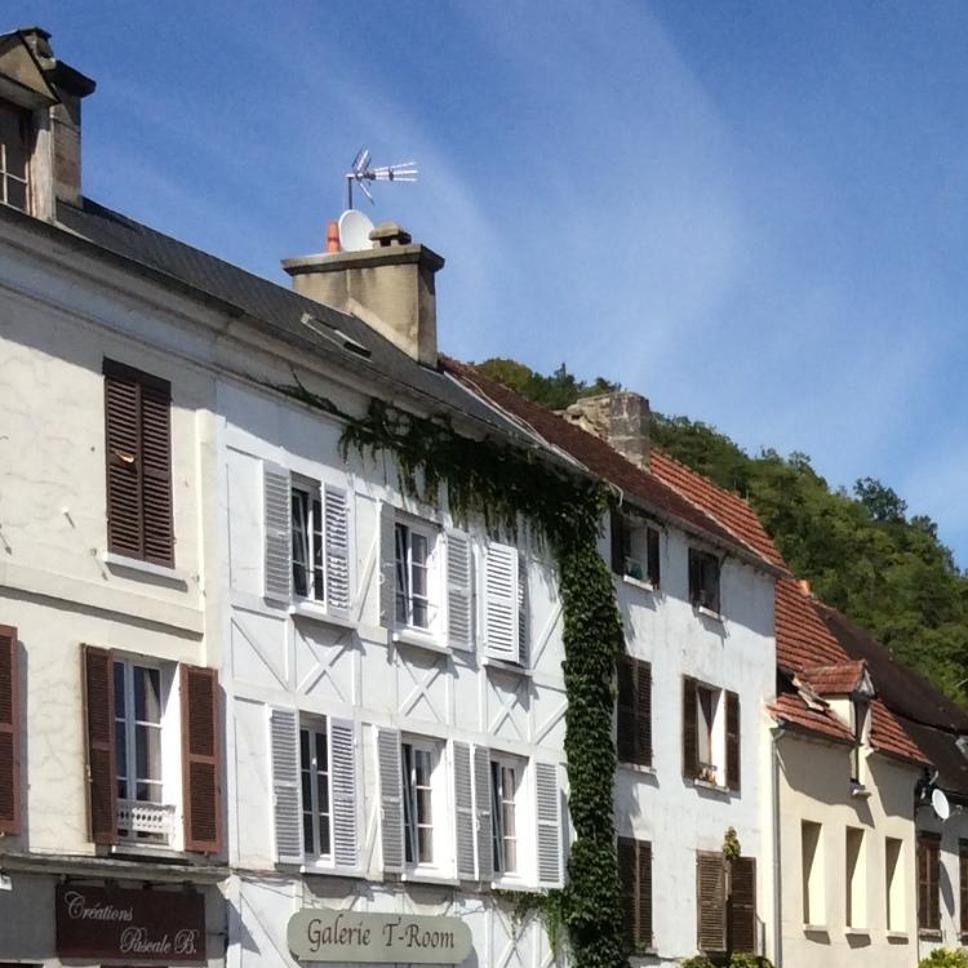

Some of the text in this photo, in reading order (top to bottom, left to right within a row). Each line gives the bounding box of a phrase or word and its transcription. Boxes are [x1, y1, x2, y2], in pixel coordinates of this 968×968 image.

[64, 891, 133, 921] Créations
[120, 927, 199, 954] Pascale B.
[307, 914, 455, 952] Galerie T-Room
